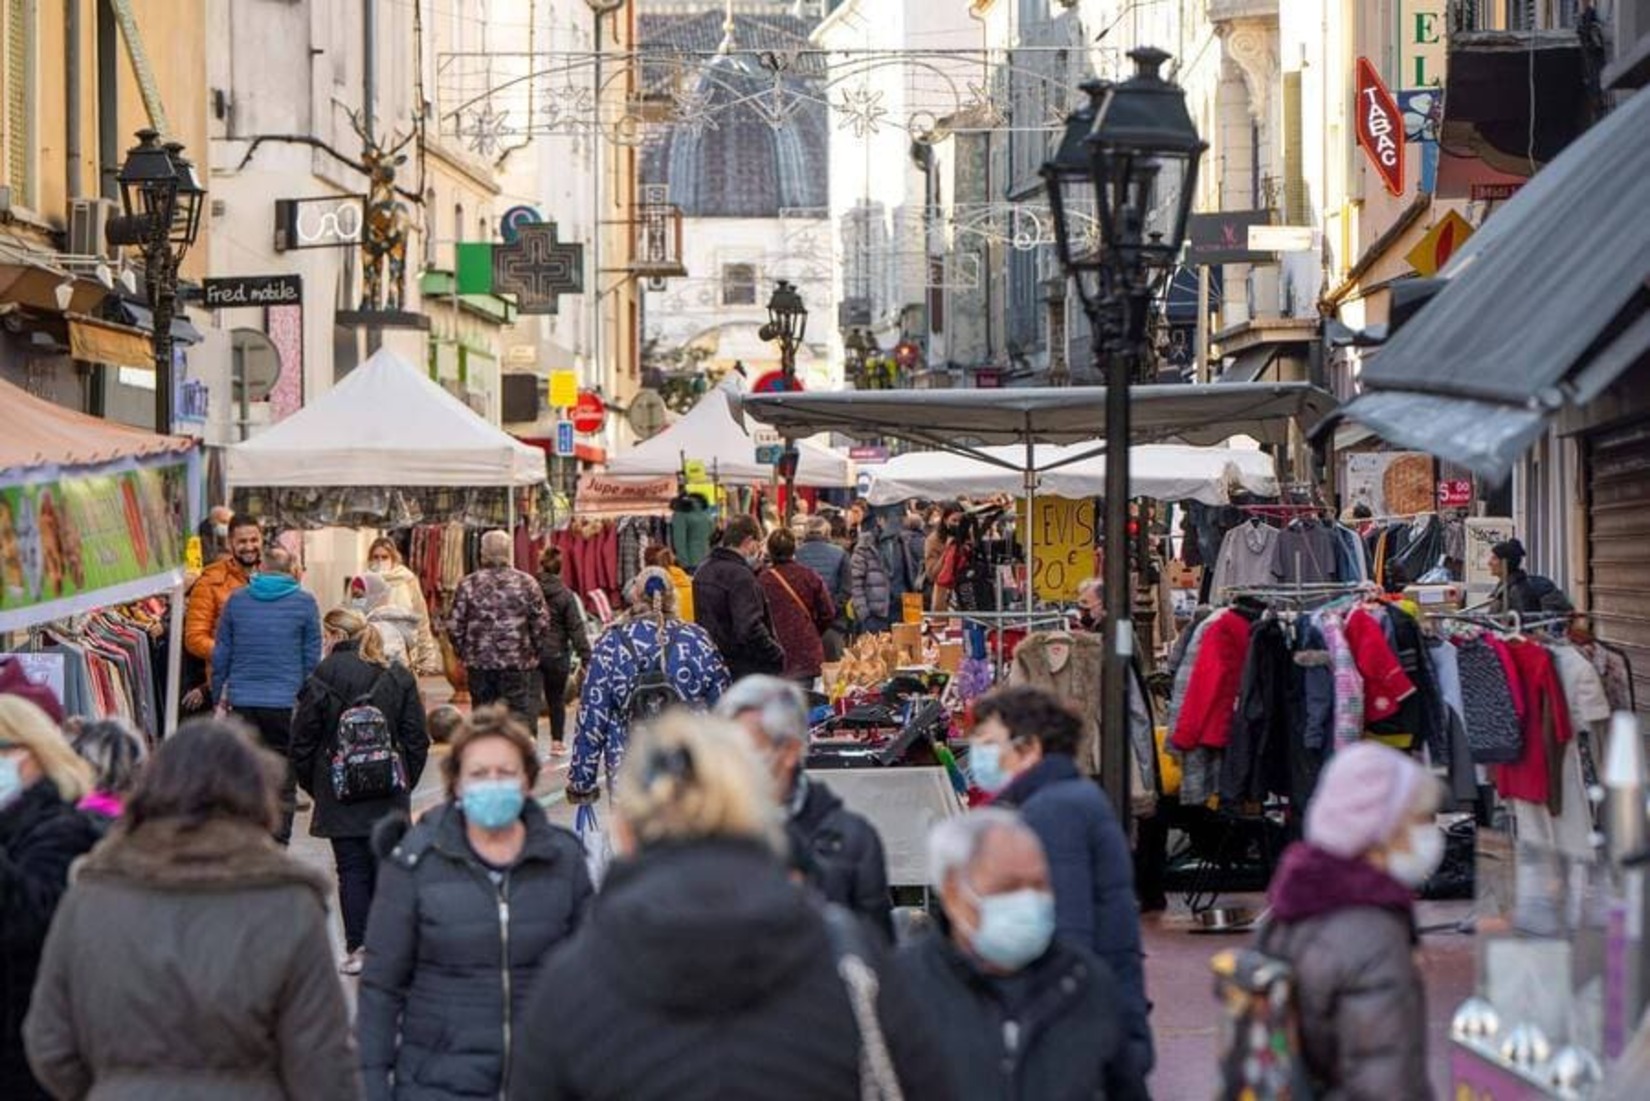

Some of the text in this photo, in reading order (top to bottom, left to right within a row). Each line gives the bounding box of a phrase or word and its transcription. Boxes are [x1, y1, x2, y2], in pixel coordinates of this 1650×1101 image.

[1363, 87, 1397, 166] TABAC
[206, 284, 247, 302] Fred
[586, 477, 620, 495] Jupe
